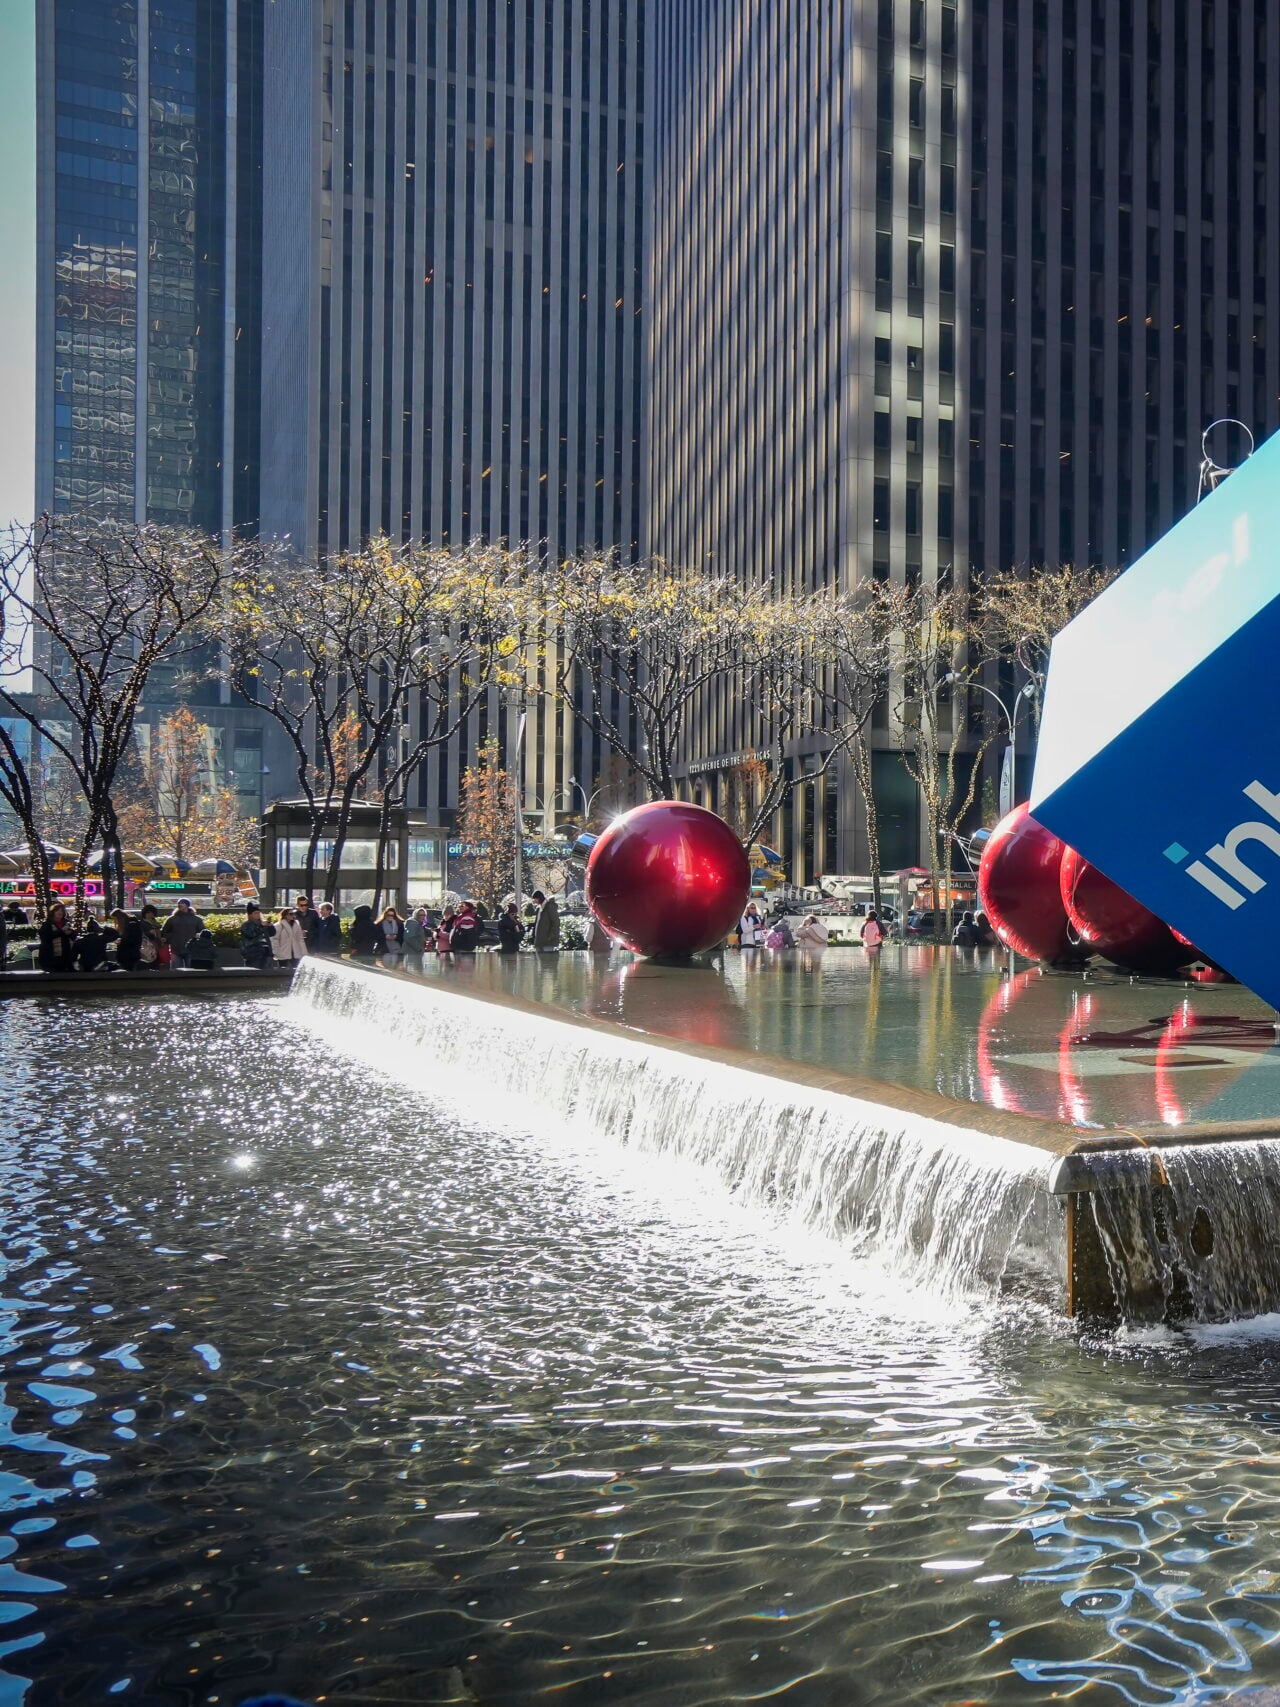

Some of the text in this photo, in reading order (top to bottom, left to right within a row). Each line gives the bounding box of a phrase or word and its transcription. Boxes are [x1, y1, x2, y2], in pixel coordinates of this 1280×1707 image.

[701, 760, 720, 771] AVENUE
[721, 758, 729, 768] OF
[730, 755, 741, 766] THE
[949, 881, 973, 889] HALAL
